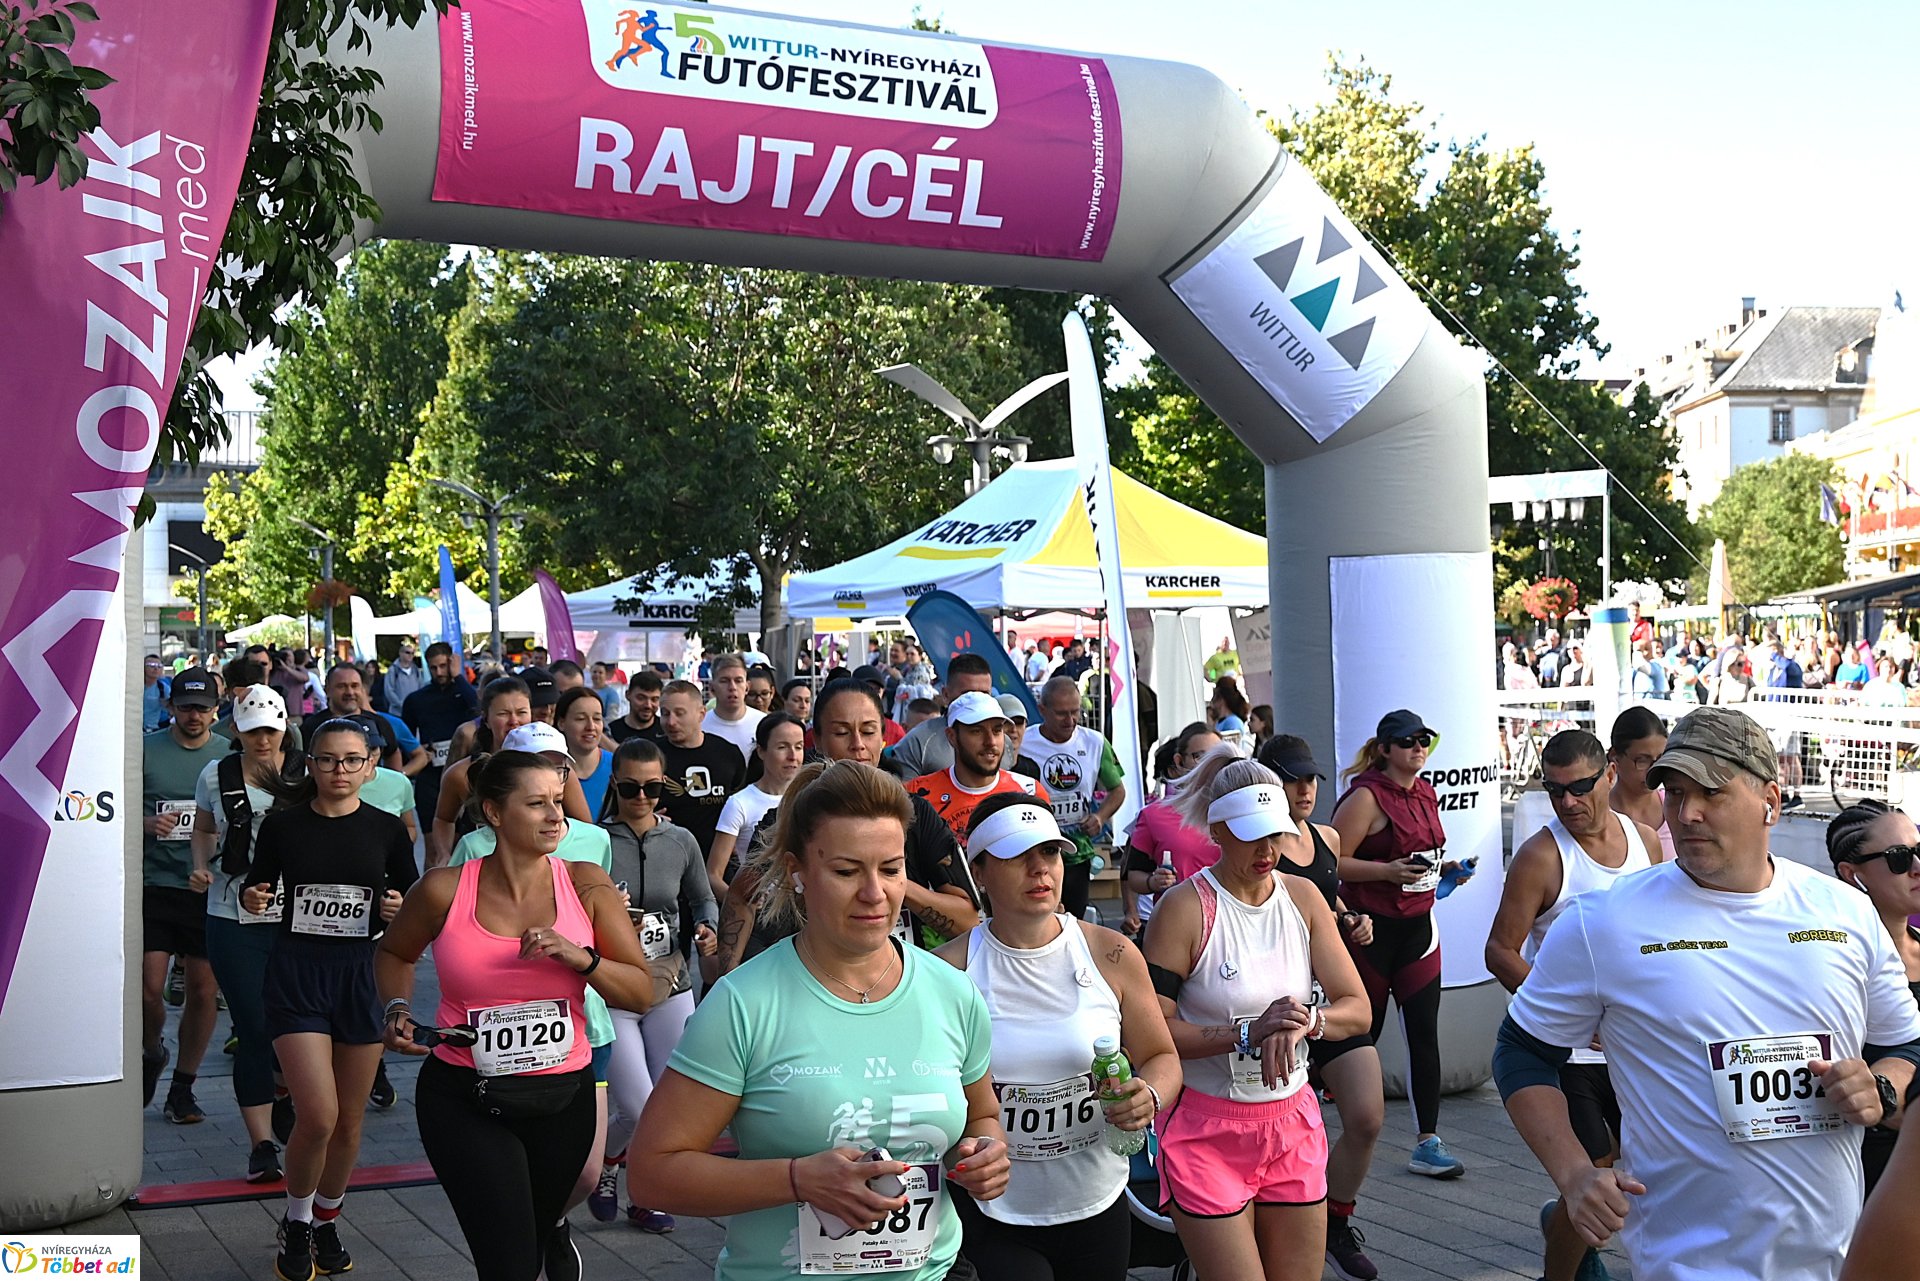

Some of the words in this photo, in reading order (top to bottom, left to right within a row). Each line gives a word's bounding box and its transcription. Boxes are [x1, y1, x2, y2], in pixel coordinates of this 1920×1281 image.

[728, 34, 981, 78] WITTUR-NYÍREGYHÁZI
[460, 11, 479, 150] www.mozaikmed.hu
[678, 53, 987, 115] FUTÓFESZTIVÁL
[574, 117, 1004, 229] RAJT/CÉL
[166, 134, 211, 262] med
[1250, 301, 1316, 373] WITTUR
[915, 519, 1037, 545] KÄRCHER
[1145, 575, 1221, 588] KÄRCHER
[303, 899, 365, 919] 10086
[1640, 943, 1666, 954] OPEL
[1700, 940, 1728, 949] TEAM
[1788, 929, 1848, 943] NORBERT
[481, 1020, 566, 1053] 10120
[794, 1065, 842, 1075] MOZAIK
[1743, 1051, 1805, 1064] FUTÓFESZTIVÁL
[1018, 1090, 1073, 1104] FUTÓFESZTIVÁL
[1003, 1096, 1094, 1134] 10116
